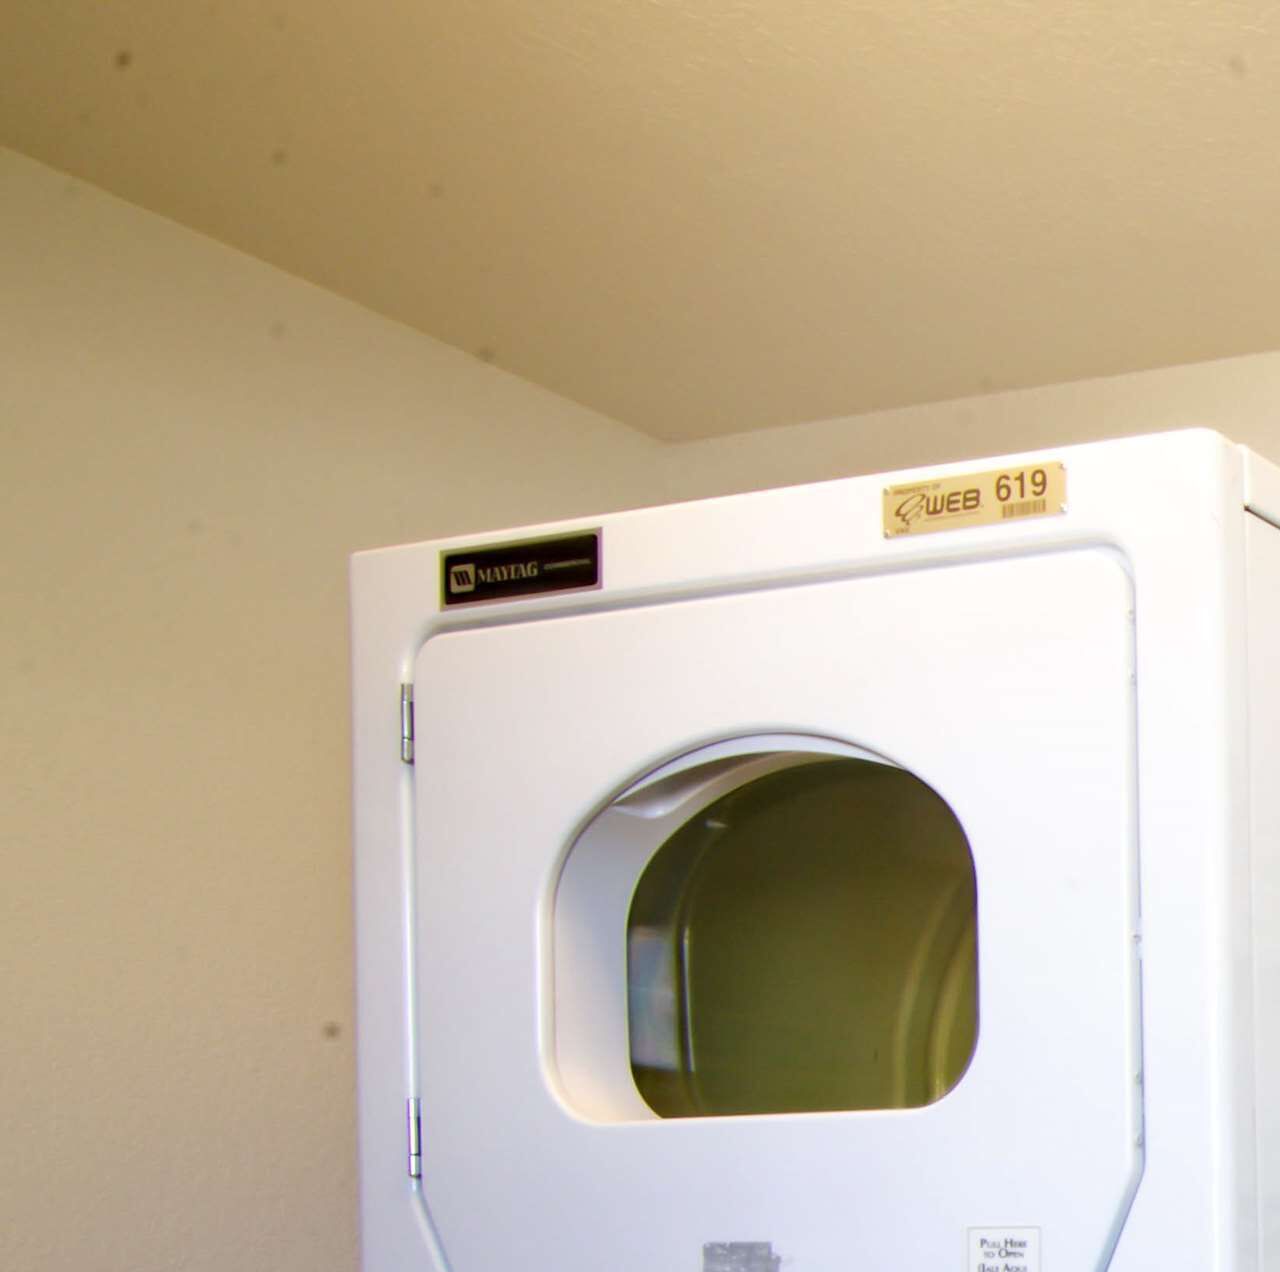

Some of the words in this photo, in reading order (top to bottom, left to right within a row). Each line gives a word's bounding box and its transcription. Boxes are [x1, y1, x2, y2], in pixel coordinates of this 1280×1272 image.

[926, 489, 981, 516] WEB
[995, 469, 1048, 502] 619
[477, 561, 539, 584] MAYTAG
